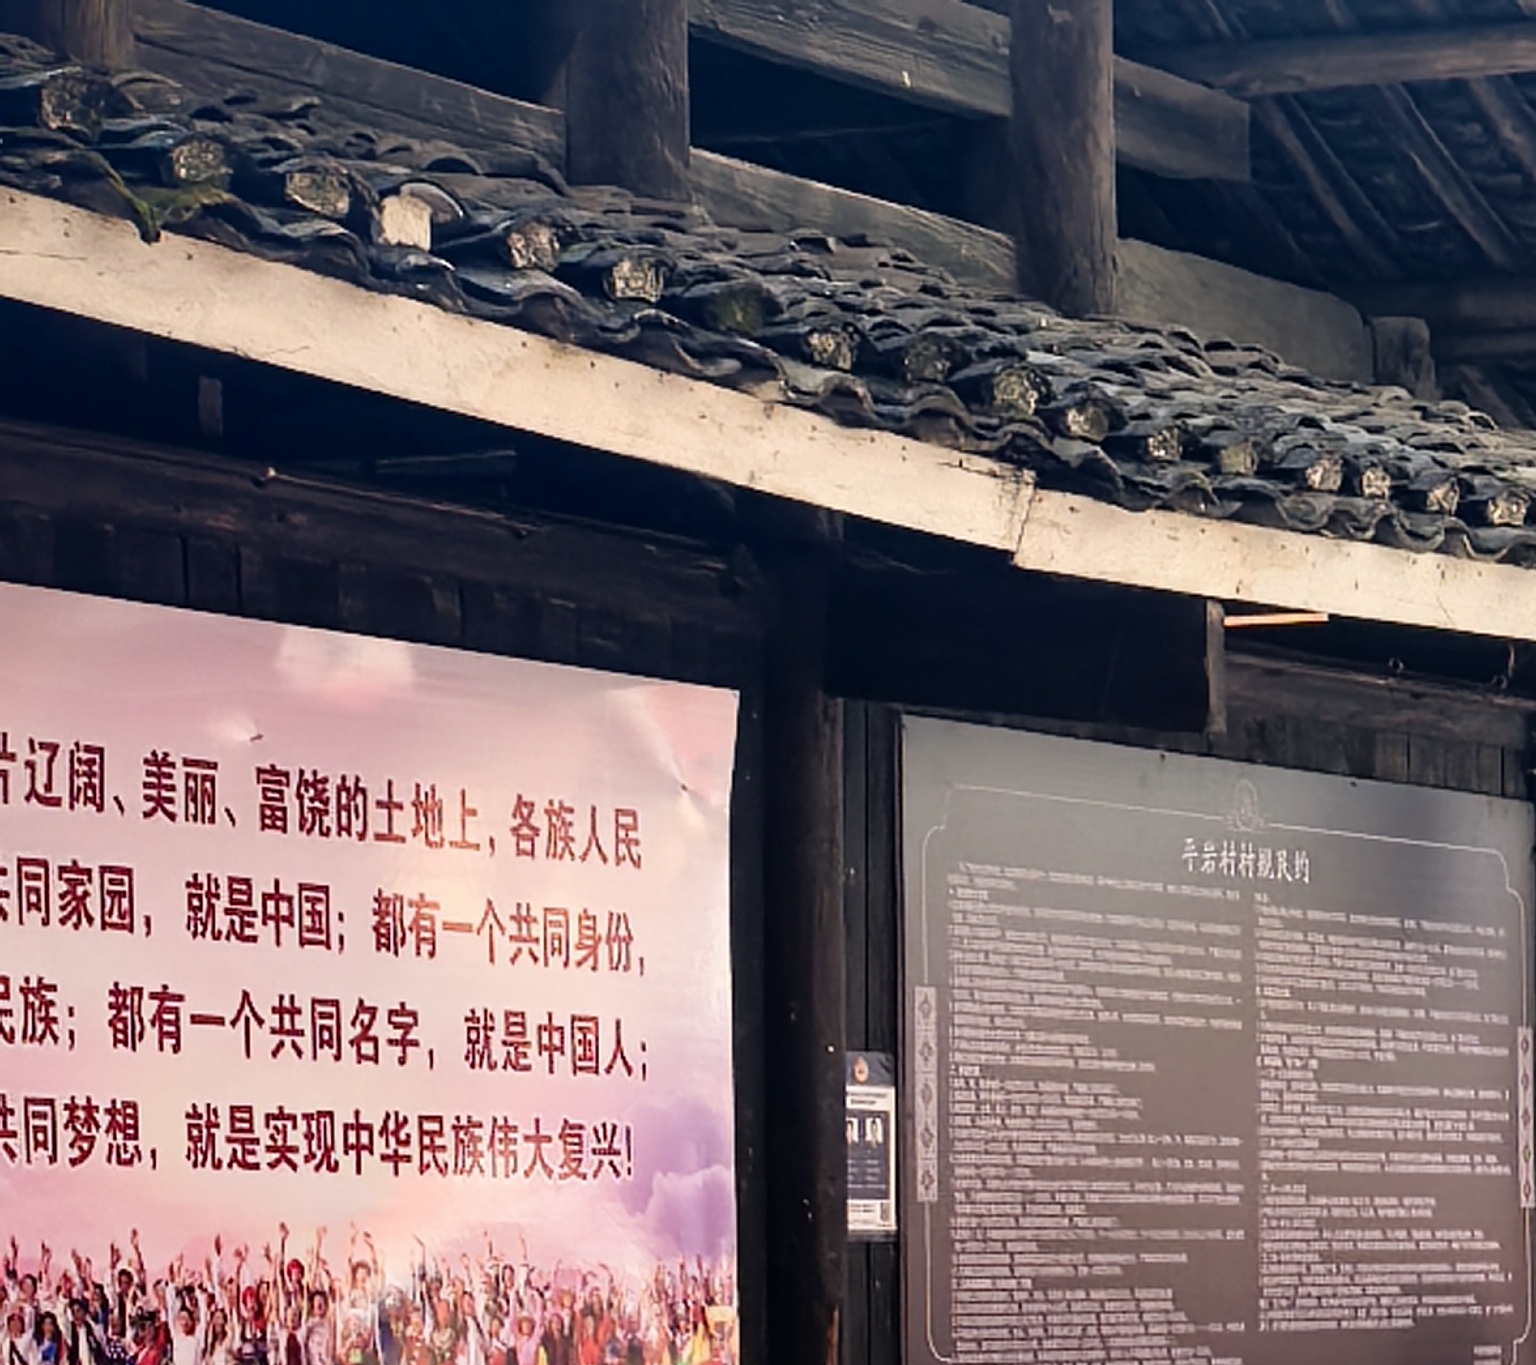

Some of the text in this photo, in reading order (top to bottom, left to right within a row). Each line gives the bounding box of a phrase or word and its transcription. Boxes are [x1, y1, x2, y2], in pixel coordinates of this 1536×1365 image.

[1181, 838, 1309, 884] 平岩村村规民约
[0, 856, 645, 977] 同家园，就是中国；都有一个共同身份，
